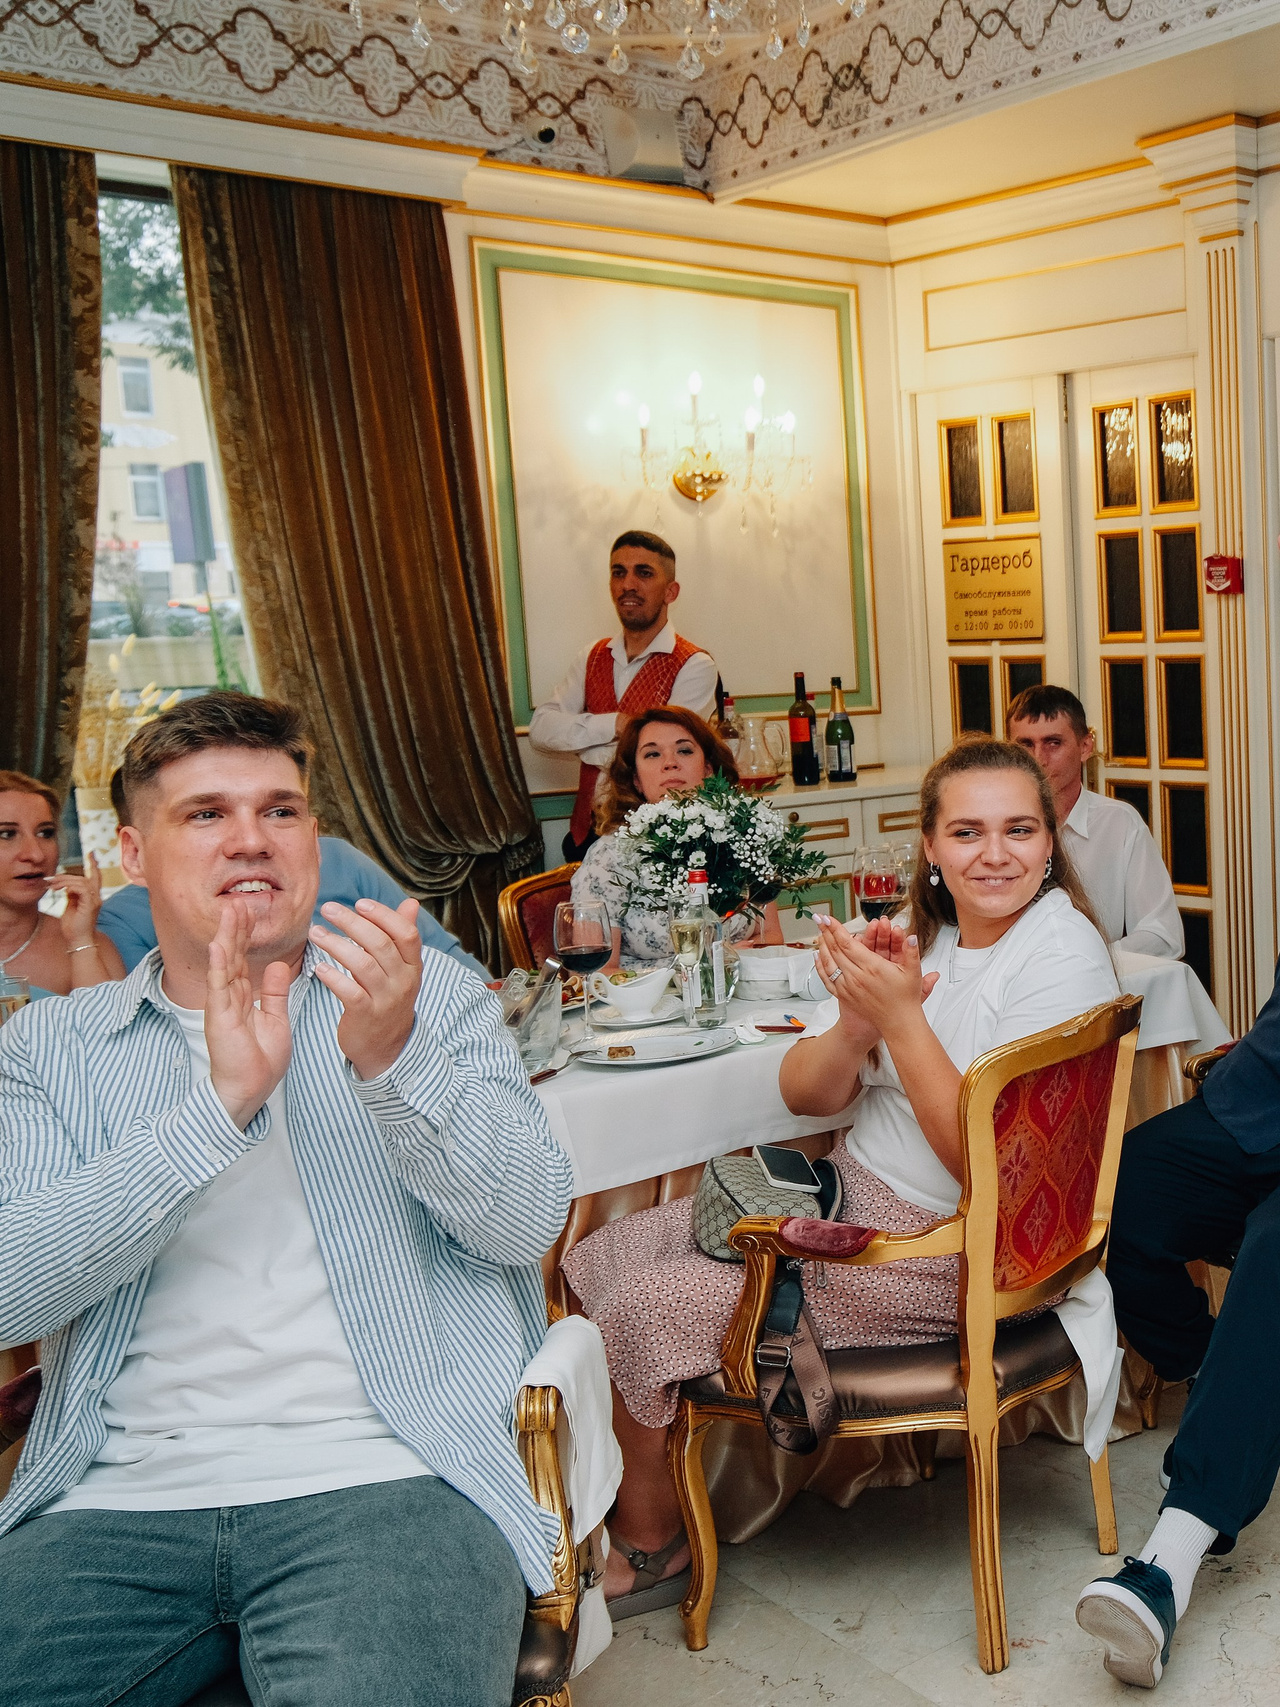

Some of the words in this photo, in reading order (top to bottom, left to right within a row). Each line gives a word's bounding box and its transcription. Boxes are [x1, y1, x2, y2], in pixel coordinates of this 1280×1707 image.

[950, 549, 1033, 576] Гардероб
[953, 589, 1031, 600] Самообслуживание
[964, 609, 988, 619] время
[992, 607, 1022, 618] работы
[964, 621, 989, 631] 12:00
[1008, 620, 1034, 630] 00:00
